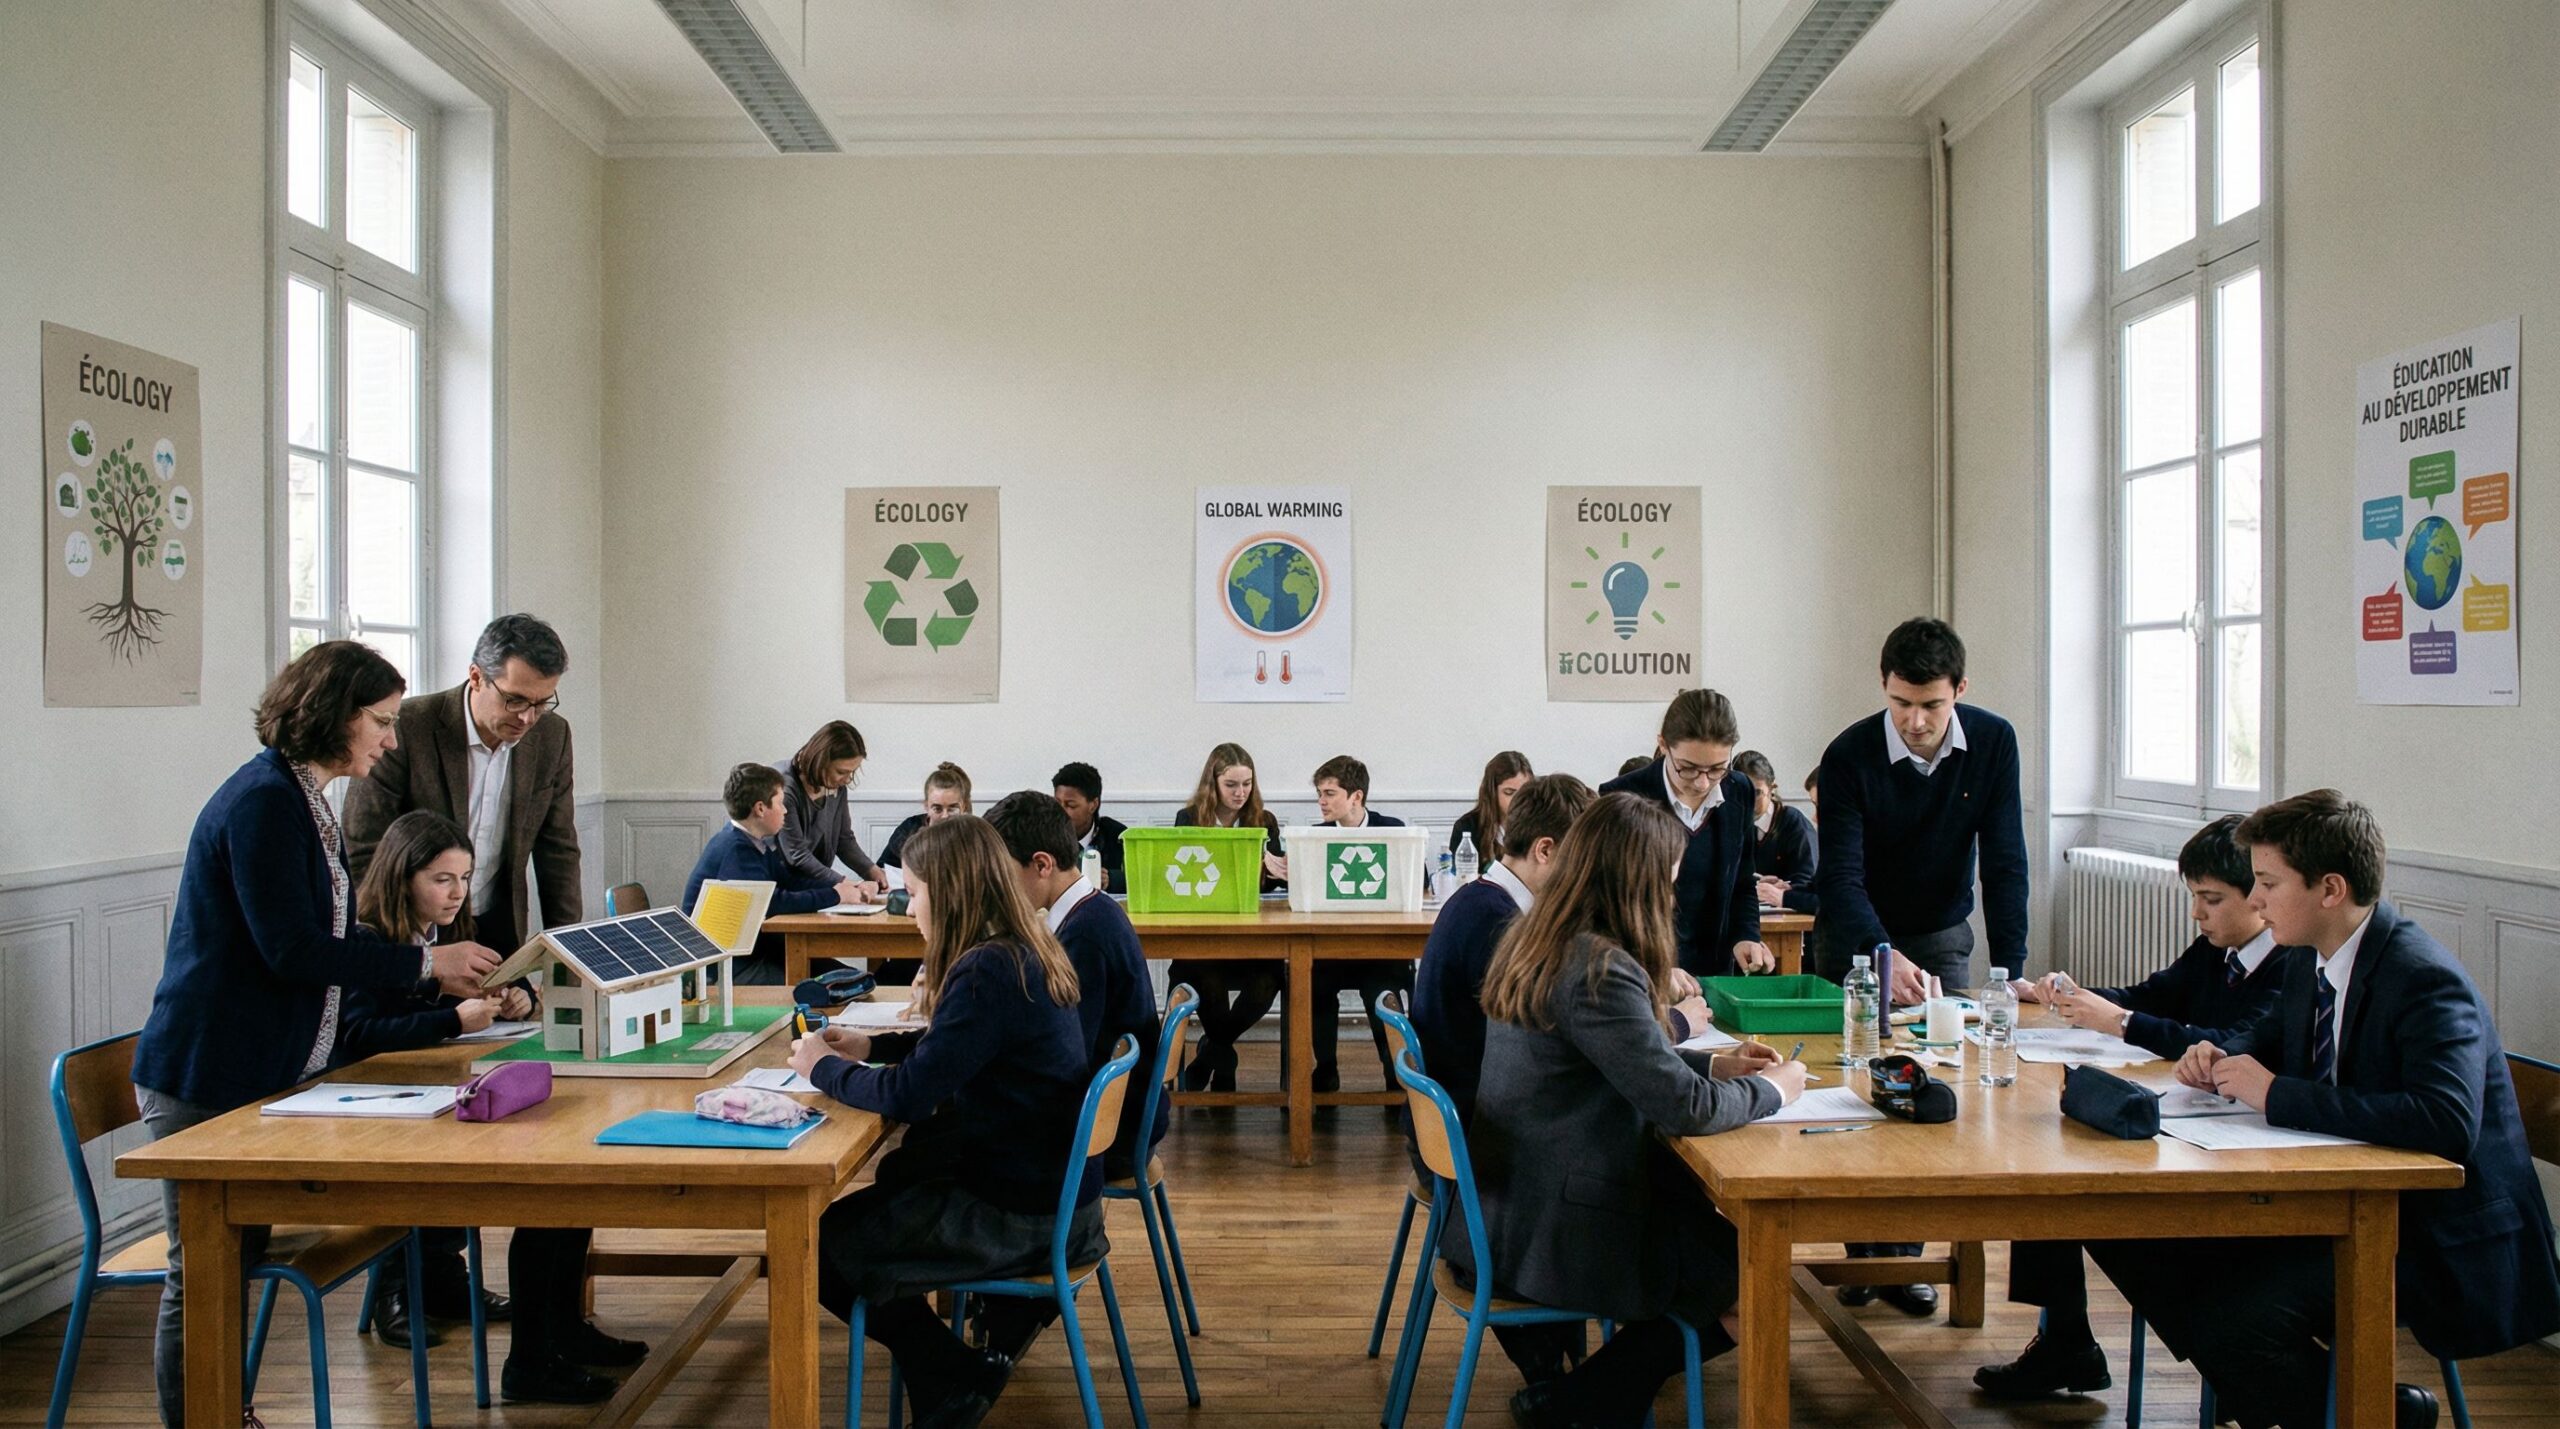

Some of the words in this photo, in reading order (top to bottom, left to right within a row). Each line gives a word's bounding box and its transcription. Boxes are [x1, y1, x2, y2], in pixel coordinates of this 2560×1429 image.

[80, 353, 173, 413] ÉCOLOGY
[2393, 346, 2473, 390] ÉDUCATION
[2362, 400, 2381, 425] AU
[2385, 366, 2512, 419] DÉVELOPPEMENT
[2400, 406, 2466, 443] DURABLE
[875, 498, 969, 523] ÉCOLOGY
[1205, 502, 1263, 518] GLOBAL
[1267, 502, 1343, 518] WARMING
[1578, 497, 1673, 523] ÉCOLOGY
[1558, 652, 1691, 675] COLUTION
